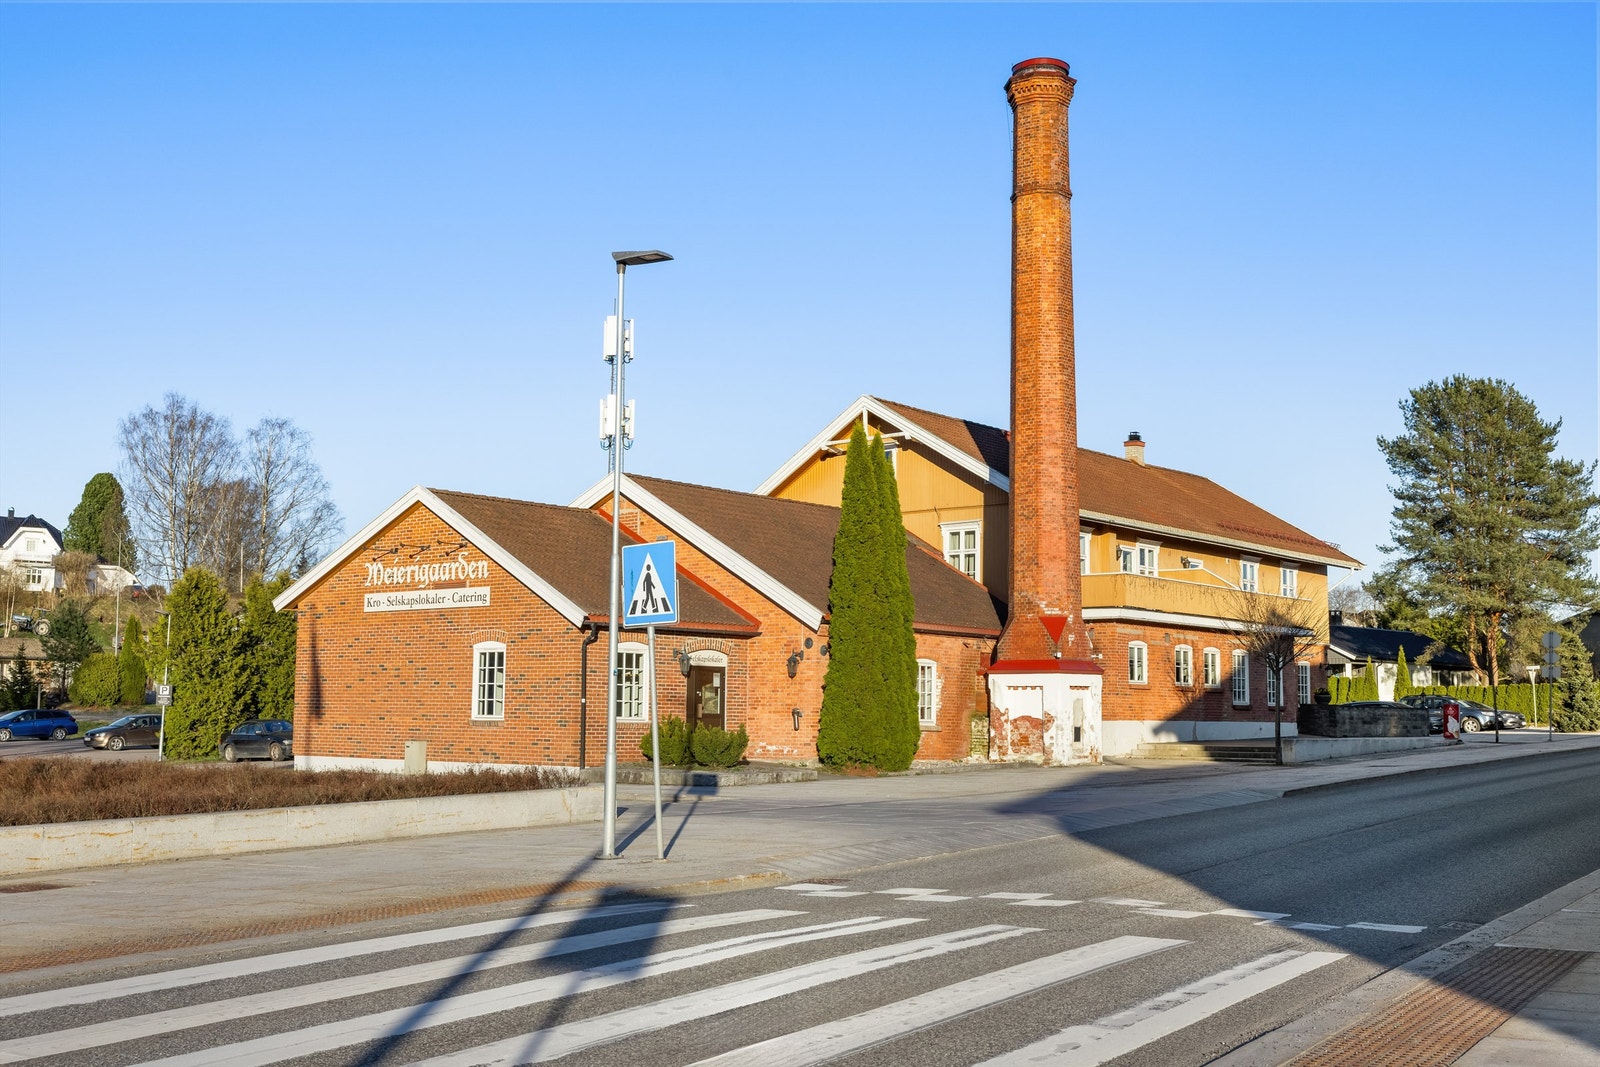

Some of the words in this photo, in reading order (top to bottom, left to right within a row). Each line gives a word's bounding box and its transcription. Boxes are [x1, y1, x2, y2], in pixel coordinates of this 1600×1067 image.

[364, 552, 489, 588] Meierigaarden
[366, 597, 381, 608] Kro
[386, 593, 446, 608] Selskapslokaler
[451, 591, 488, 604] Catering
[690, 654, 723, 663] elskapslokaler
